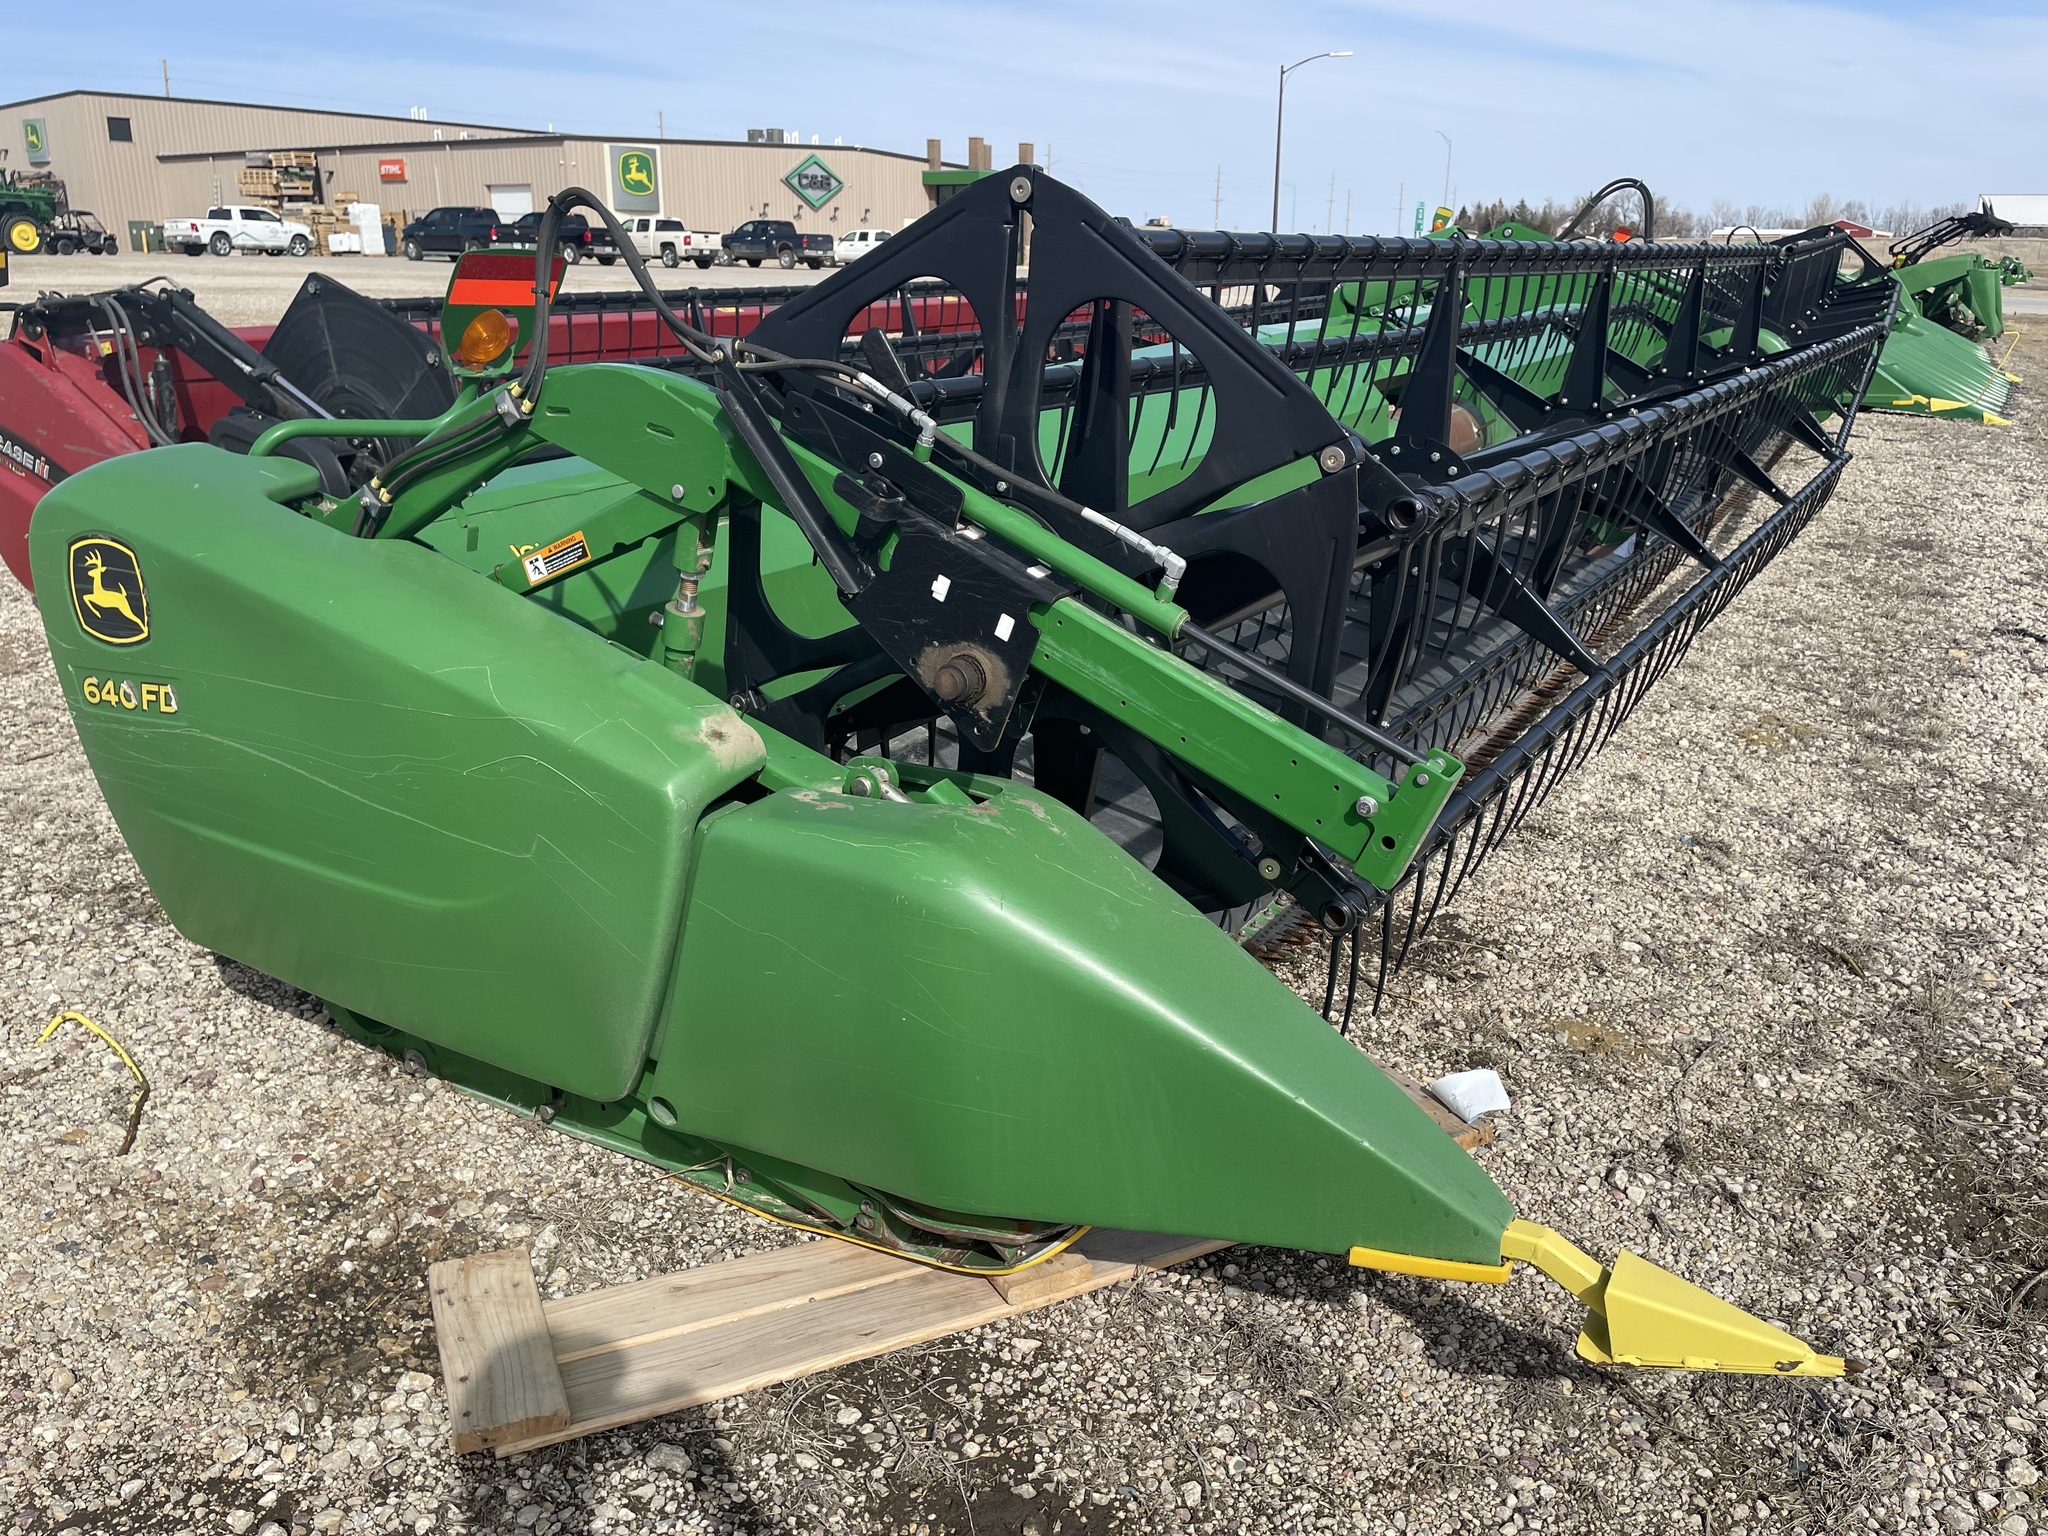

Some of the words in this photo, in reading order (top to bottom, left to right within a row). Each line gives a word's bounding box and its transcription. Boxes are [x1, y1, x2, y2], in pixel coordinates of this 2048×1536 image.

[380, 164, 402, 175] STIHL
[798, 173, 832, 191] C&B
[553, 535, 577, 550] WARNING
